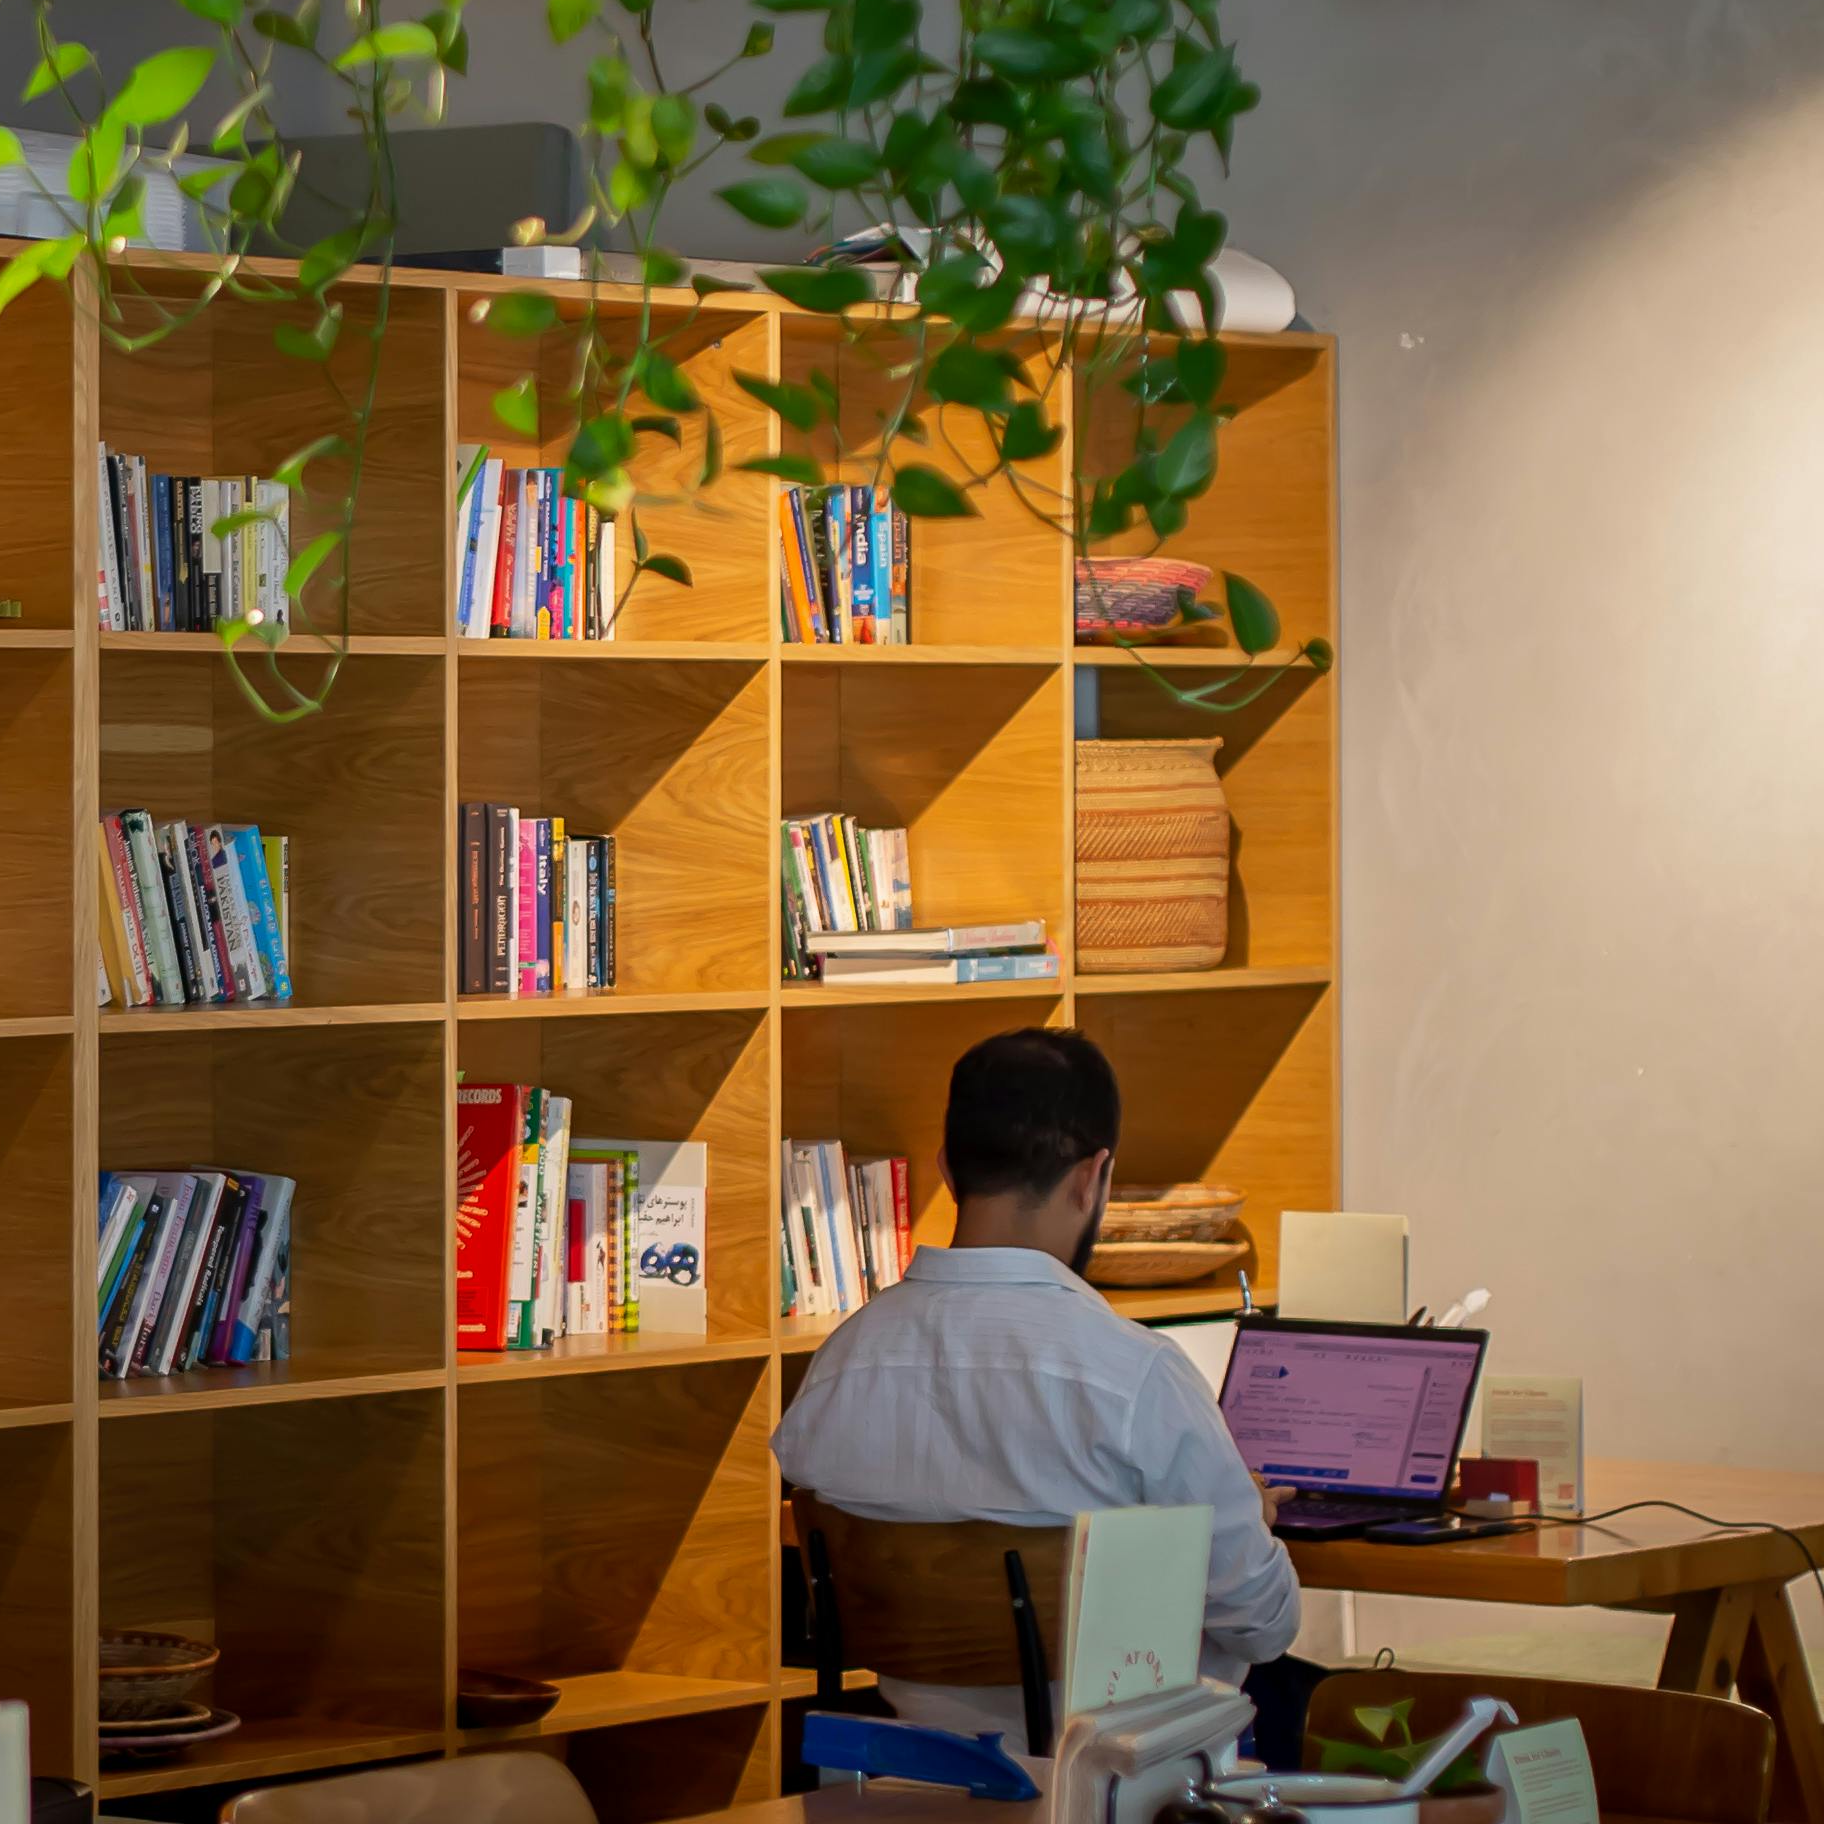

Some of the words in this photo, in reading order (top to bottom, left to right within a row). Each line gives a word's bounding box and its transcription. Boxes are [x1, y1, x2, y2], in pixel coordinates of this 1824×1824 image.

[876, 521, 890, 567] Spain
[894, 511, 902, 559] Spain
[130, 872, 143, 921] Patterson
[538, 854, 547, 895] Italy
[217, 876, 236, 952] PAKISTAN
[497, 895, 505, 955] PENDRAGON
[205, 1224, 225, 1268] Tempered
[194, 1268, 212, 1307] Radicals
